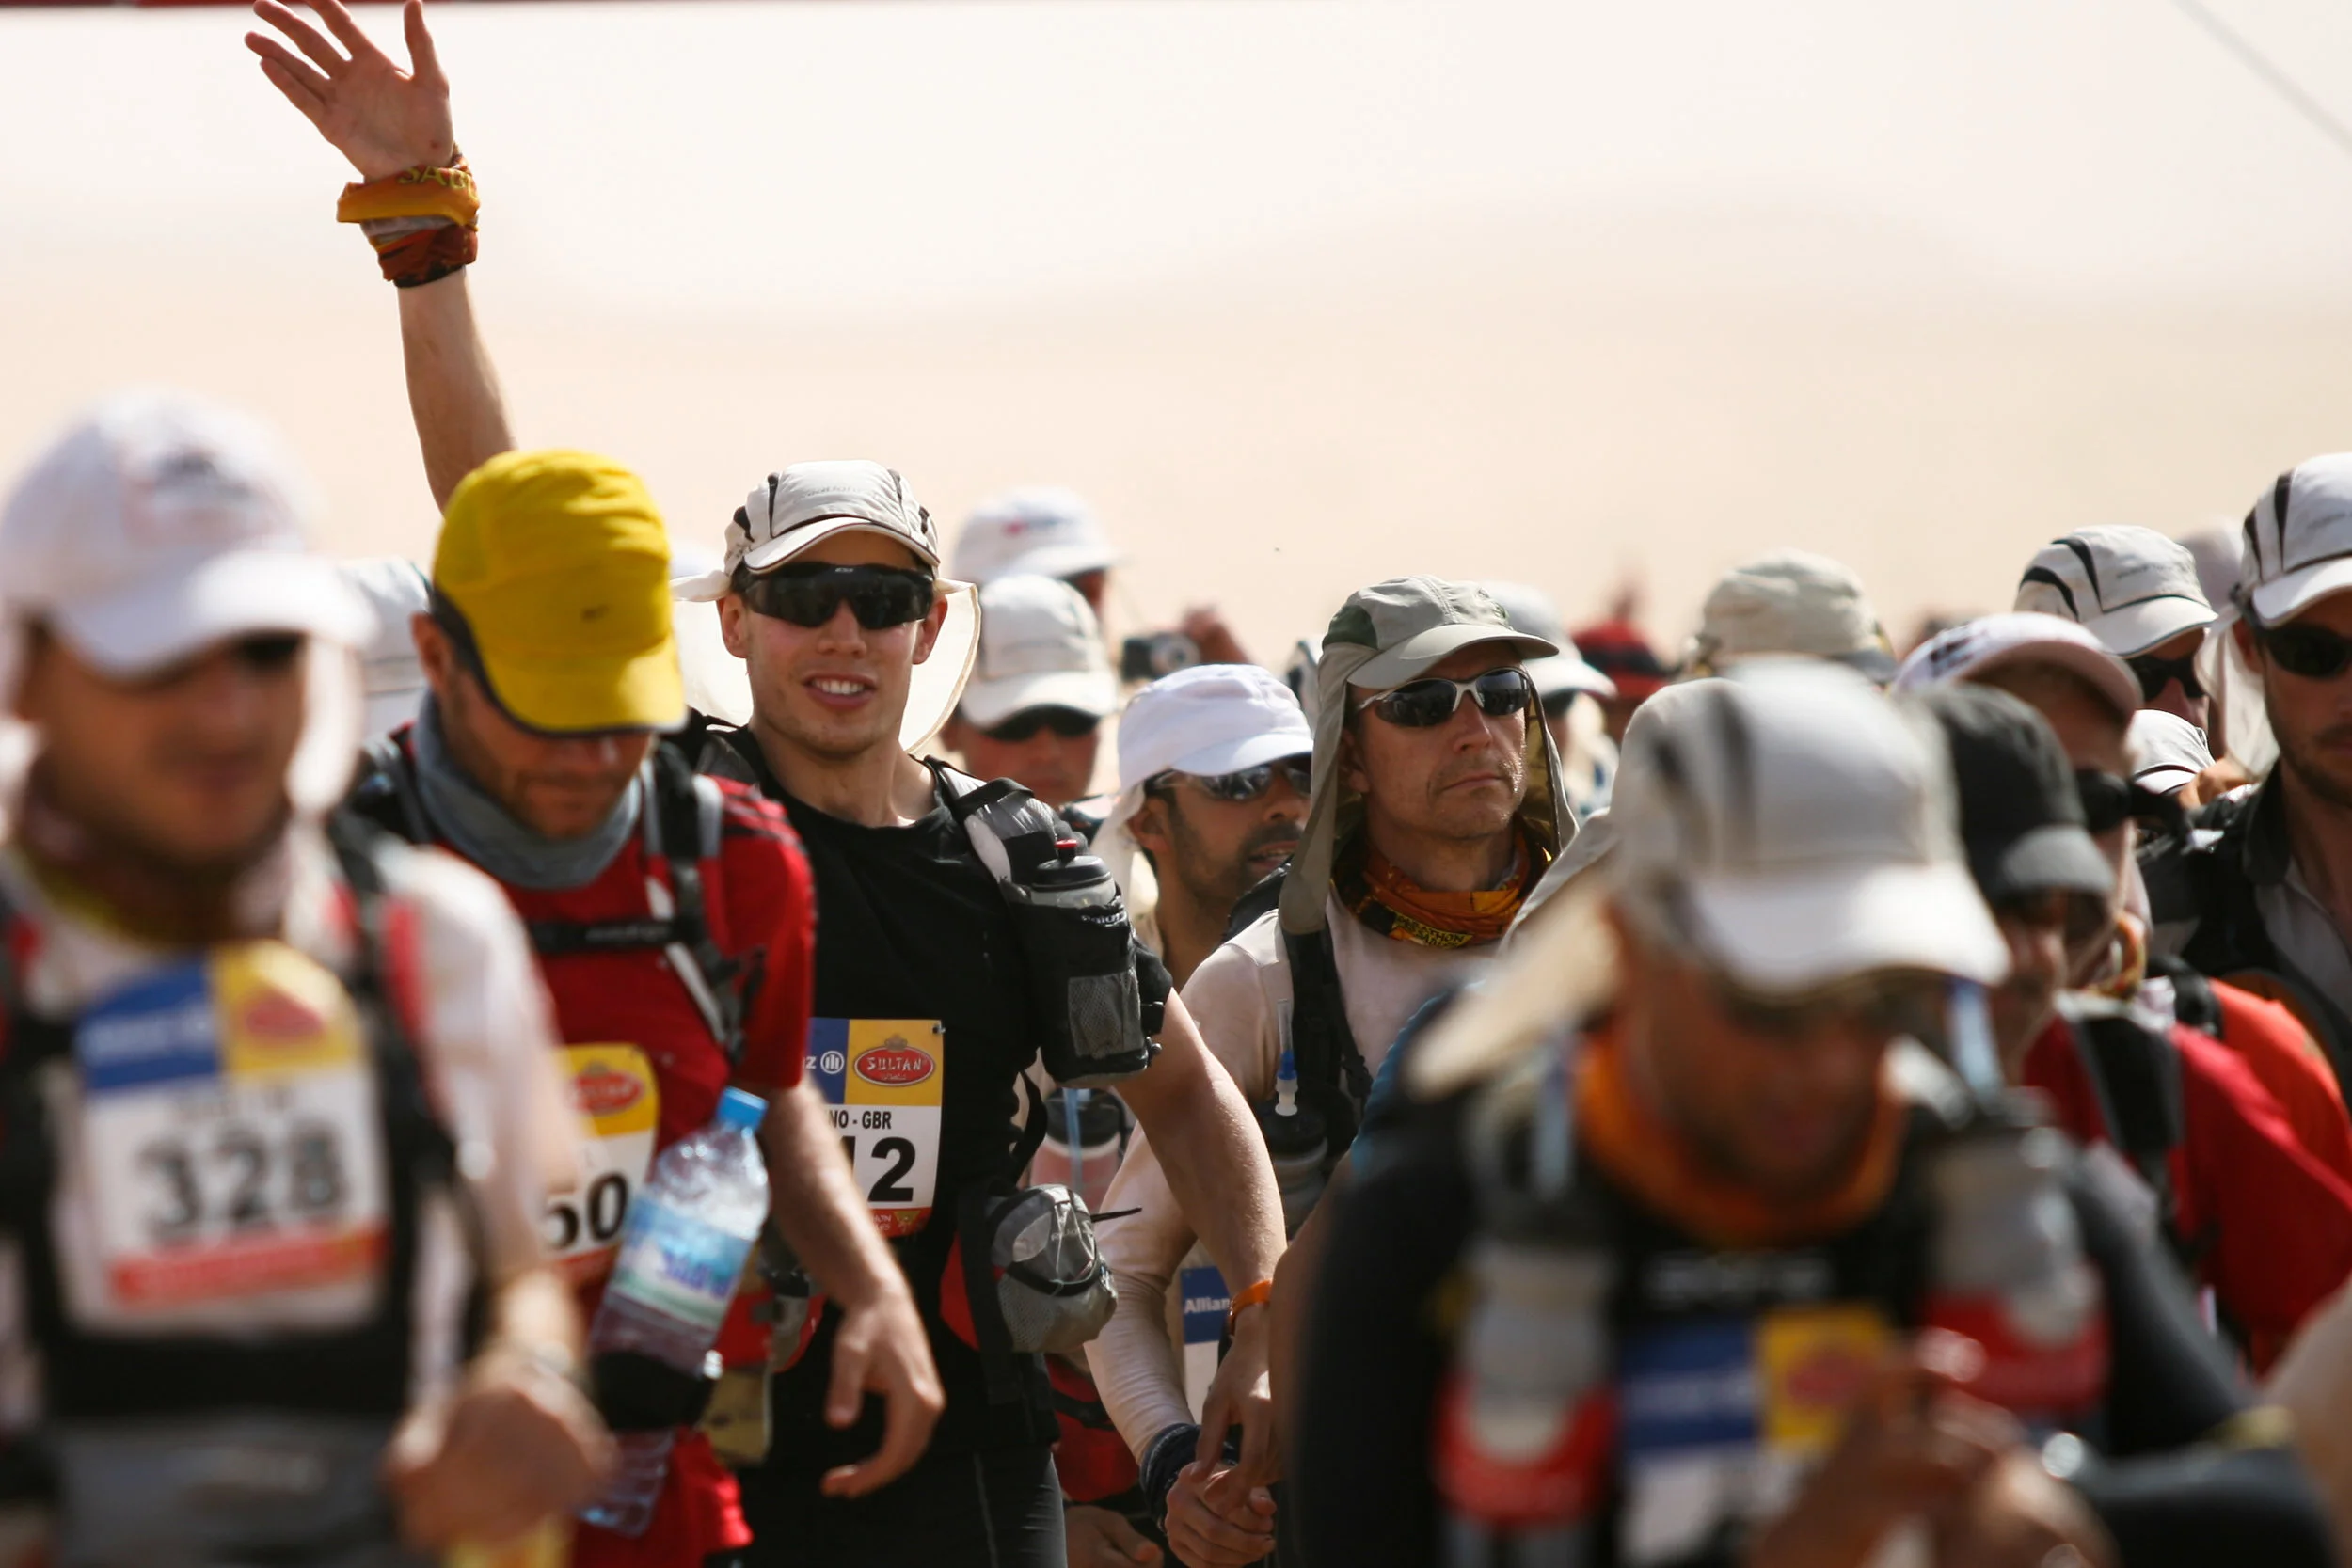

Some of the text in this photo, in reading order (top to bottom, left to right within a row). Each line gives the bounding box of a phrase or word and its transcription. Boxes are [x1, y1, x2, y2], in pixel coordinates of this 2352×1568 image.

[866, 1056, 922, 1070] SULTAN
[862, 1111, 892, 1130] GBR
[133, 1120, 351, 1247] 328
[1184, 1296, 1231, 1313] Allian
